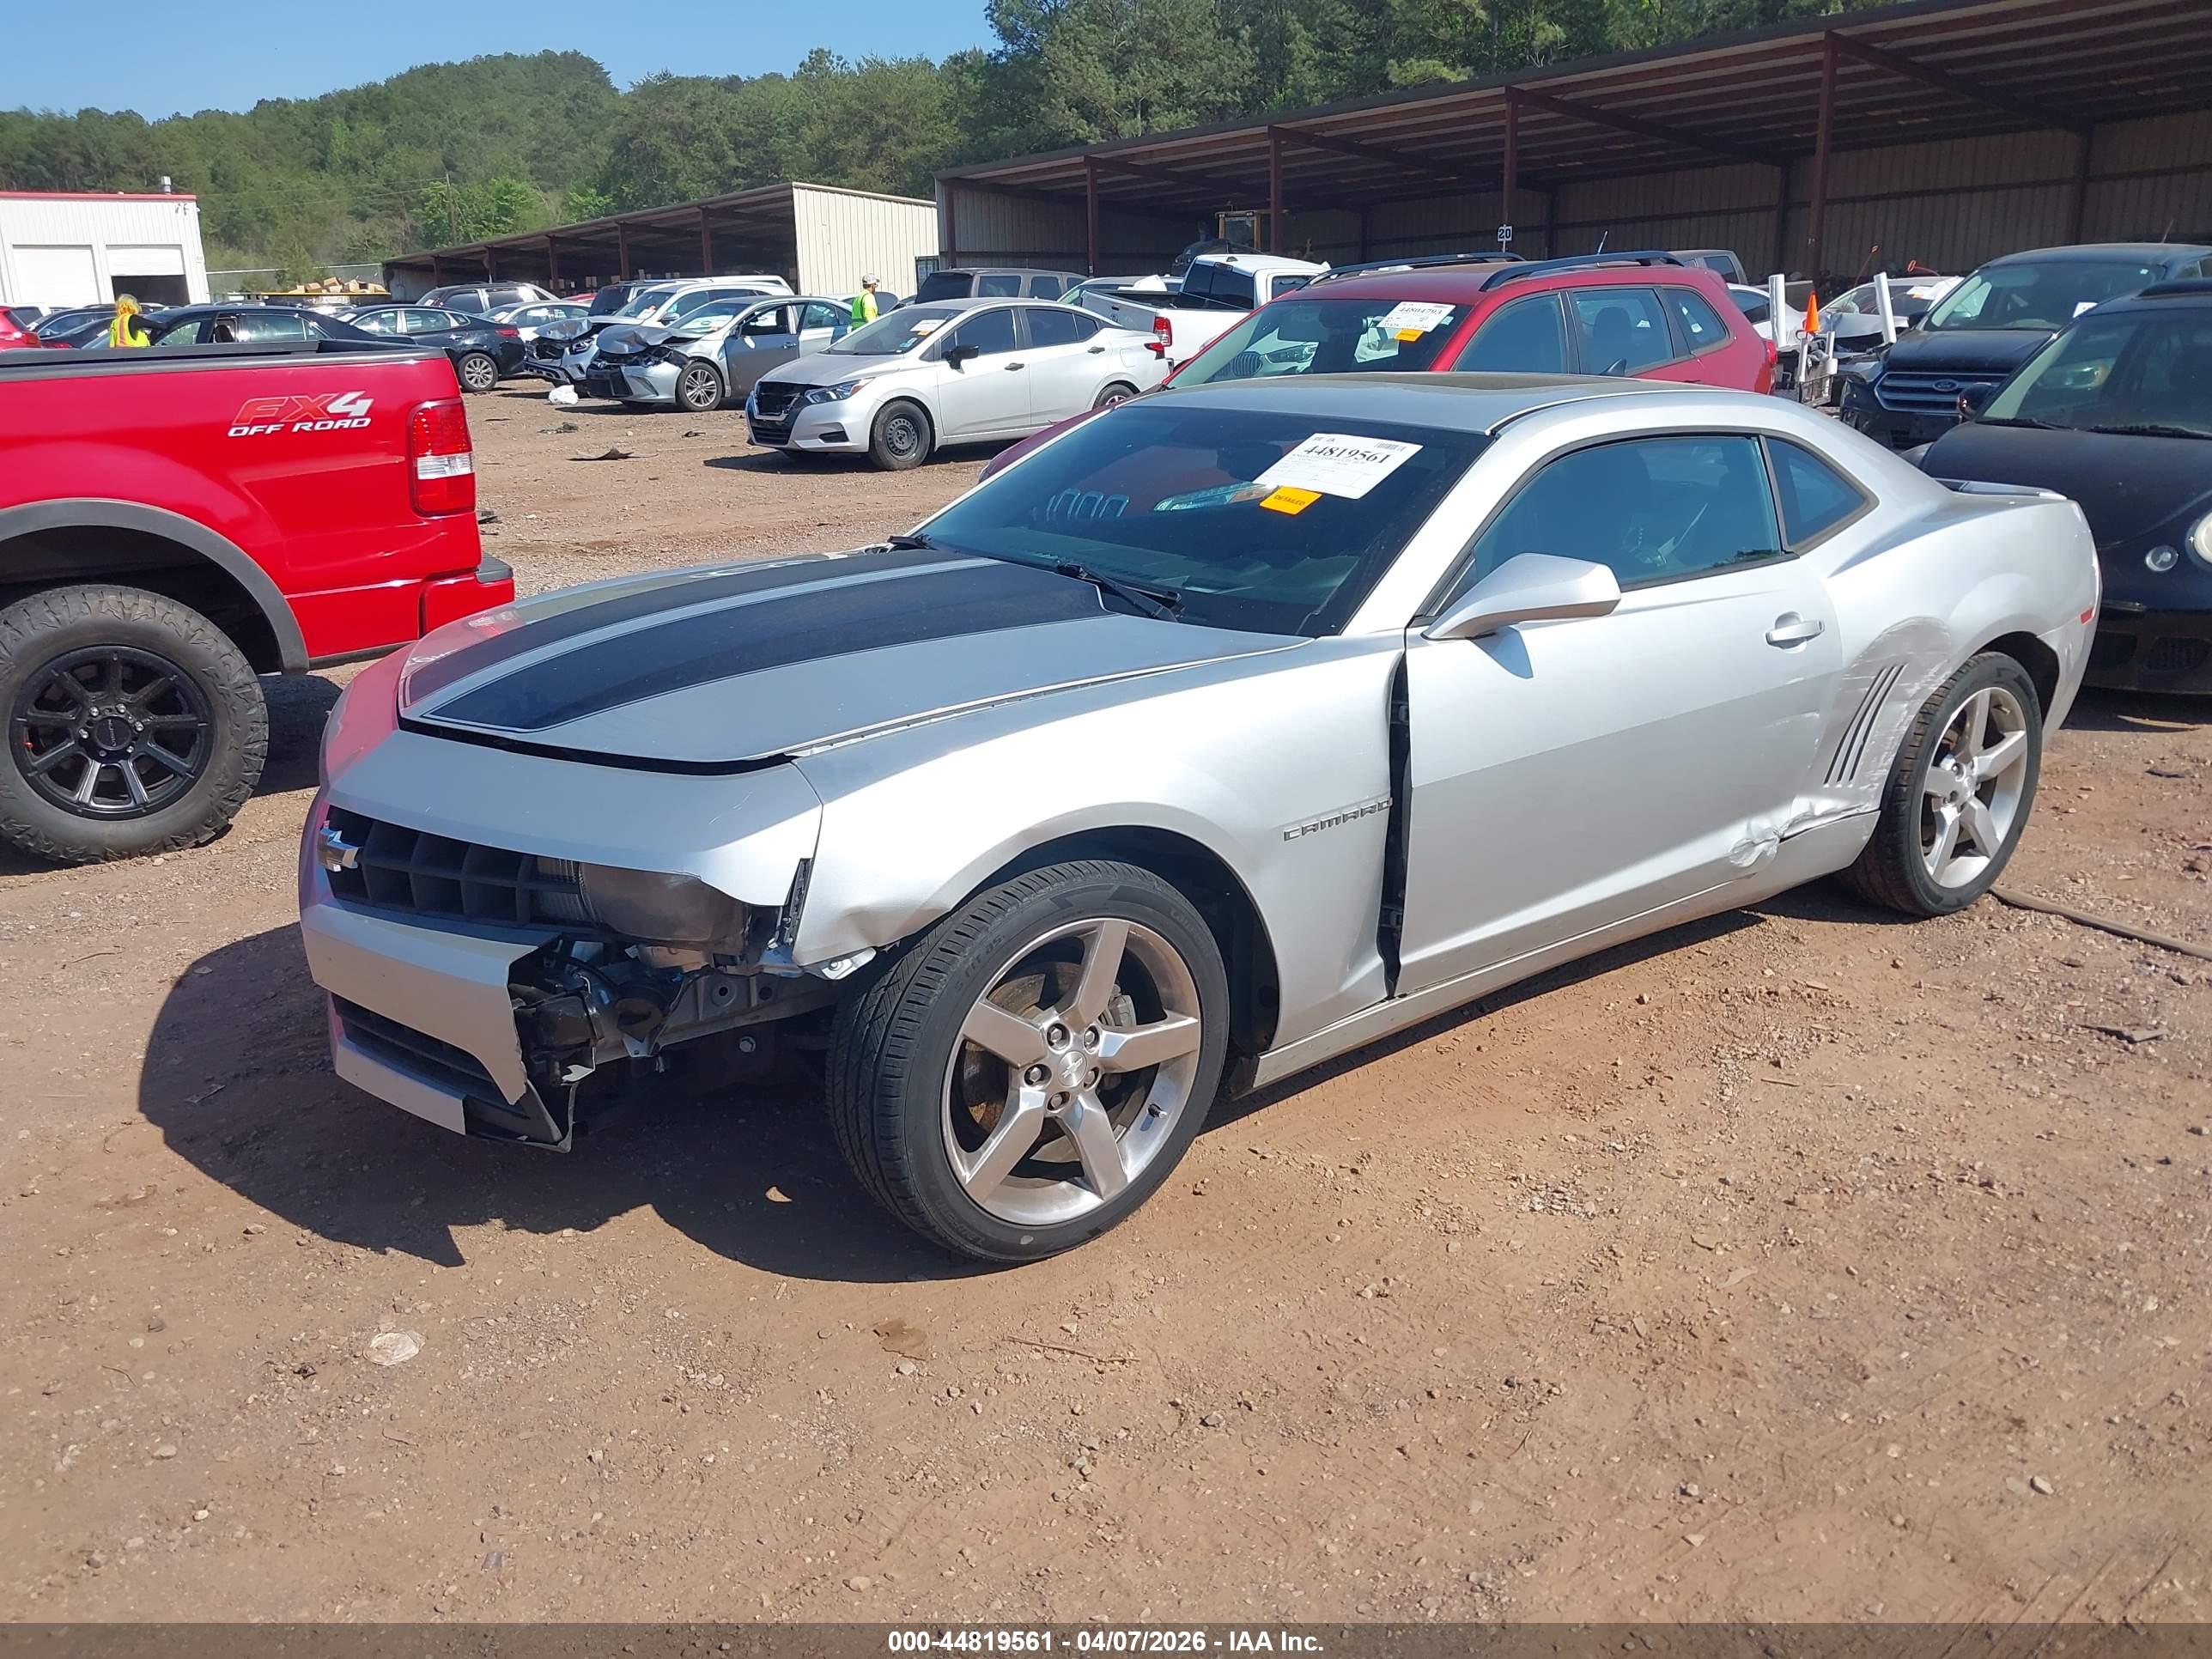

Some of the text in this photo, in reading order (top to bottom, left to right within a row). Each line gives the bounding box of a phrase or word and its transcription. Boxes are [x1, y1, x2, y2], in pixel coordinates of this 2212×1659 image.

[1498, 228, 1511, 239] 20
[232, 391, 374, 426] FX4
[228, 417, 372, 437] OFF ROAD
[1304, 445, 1392, 465] 44819561
[1273, 494, 1306, 507] DETAILED
[1283, 797, 1394, 842] CAMARO
